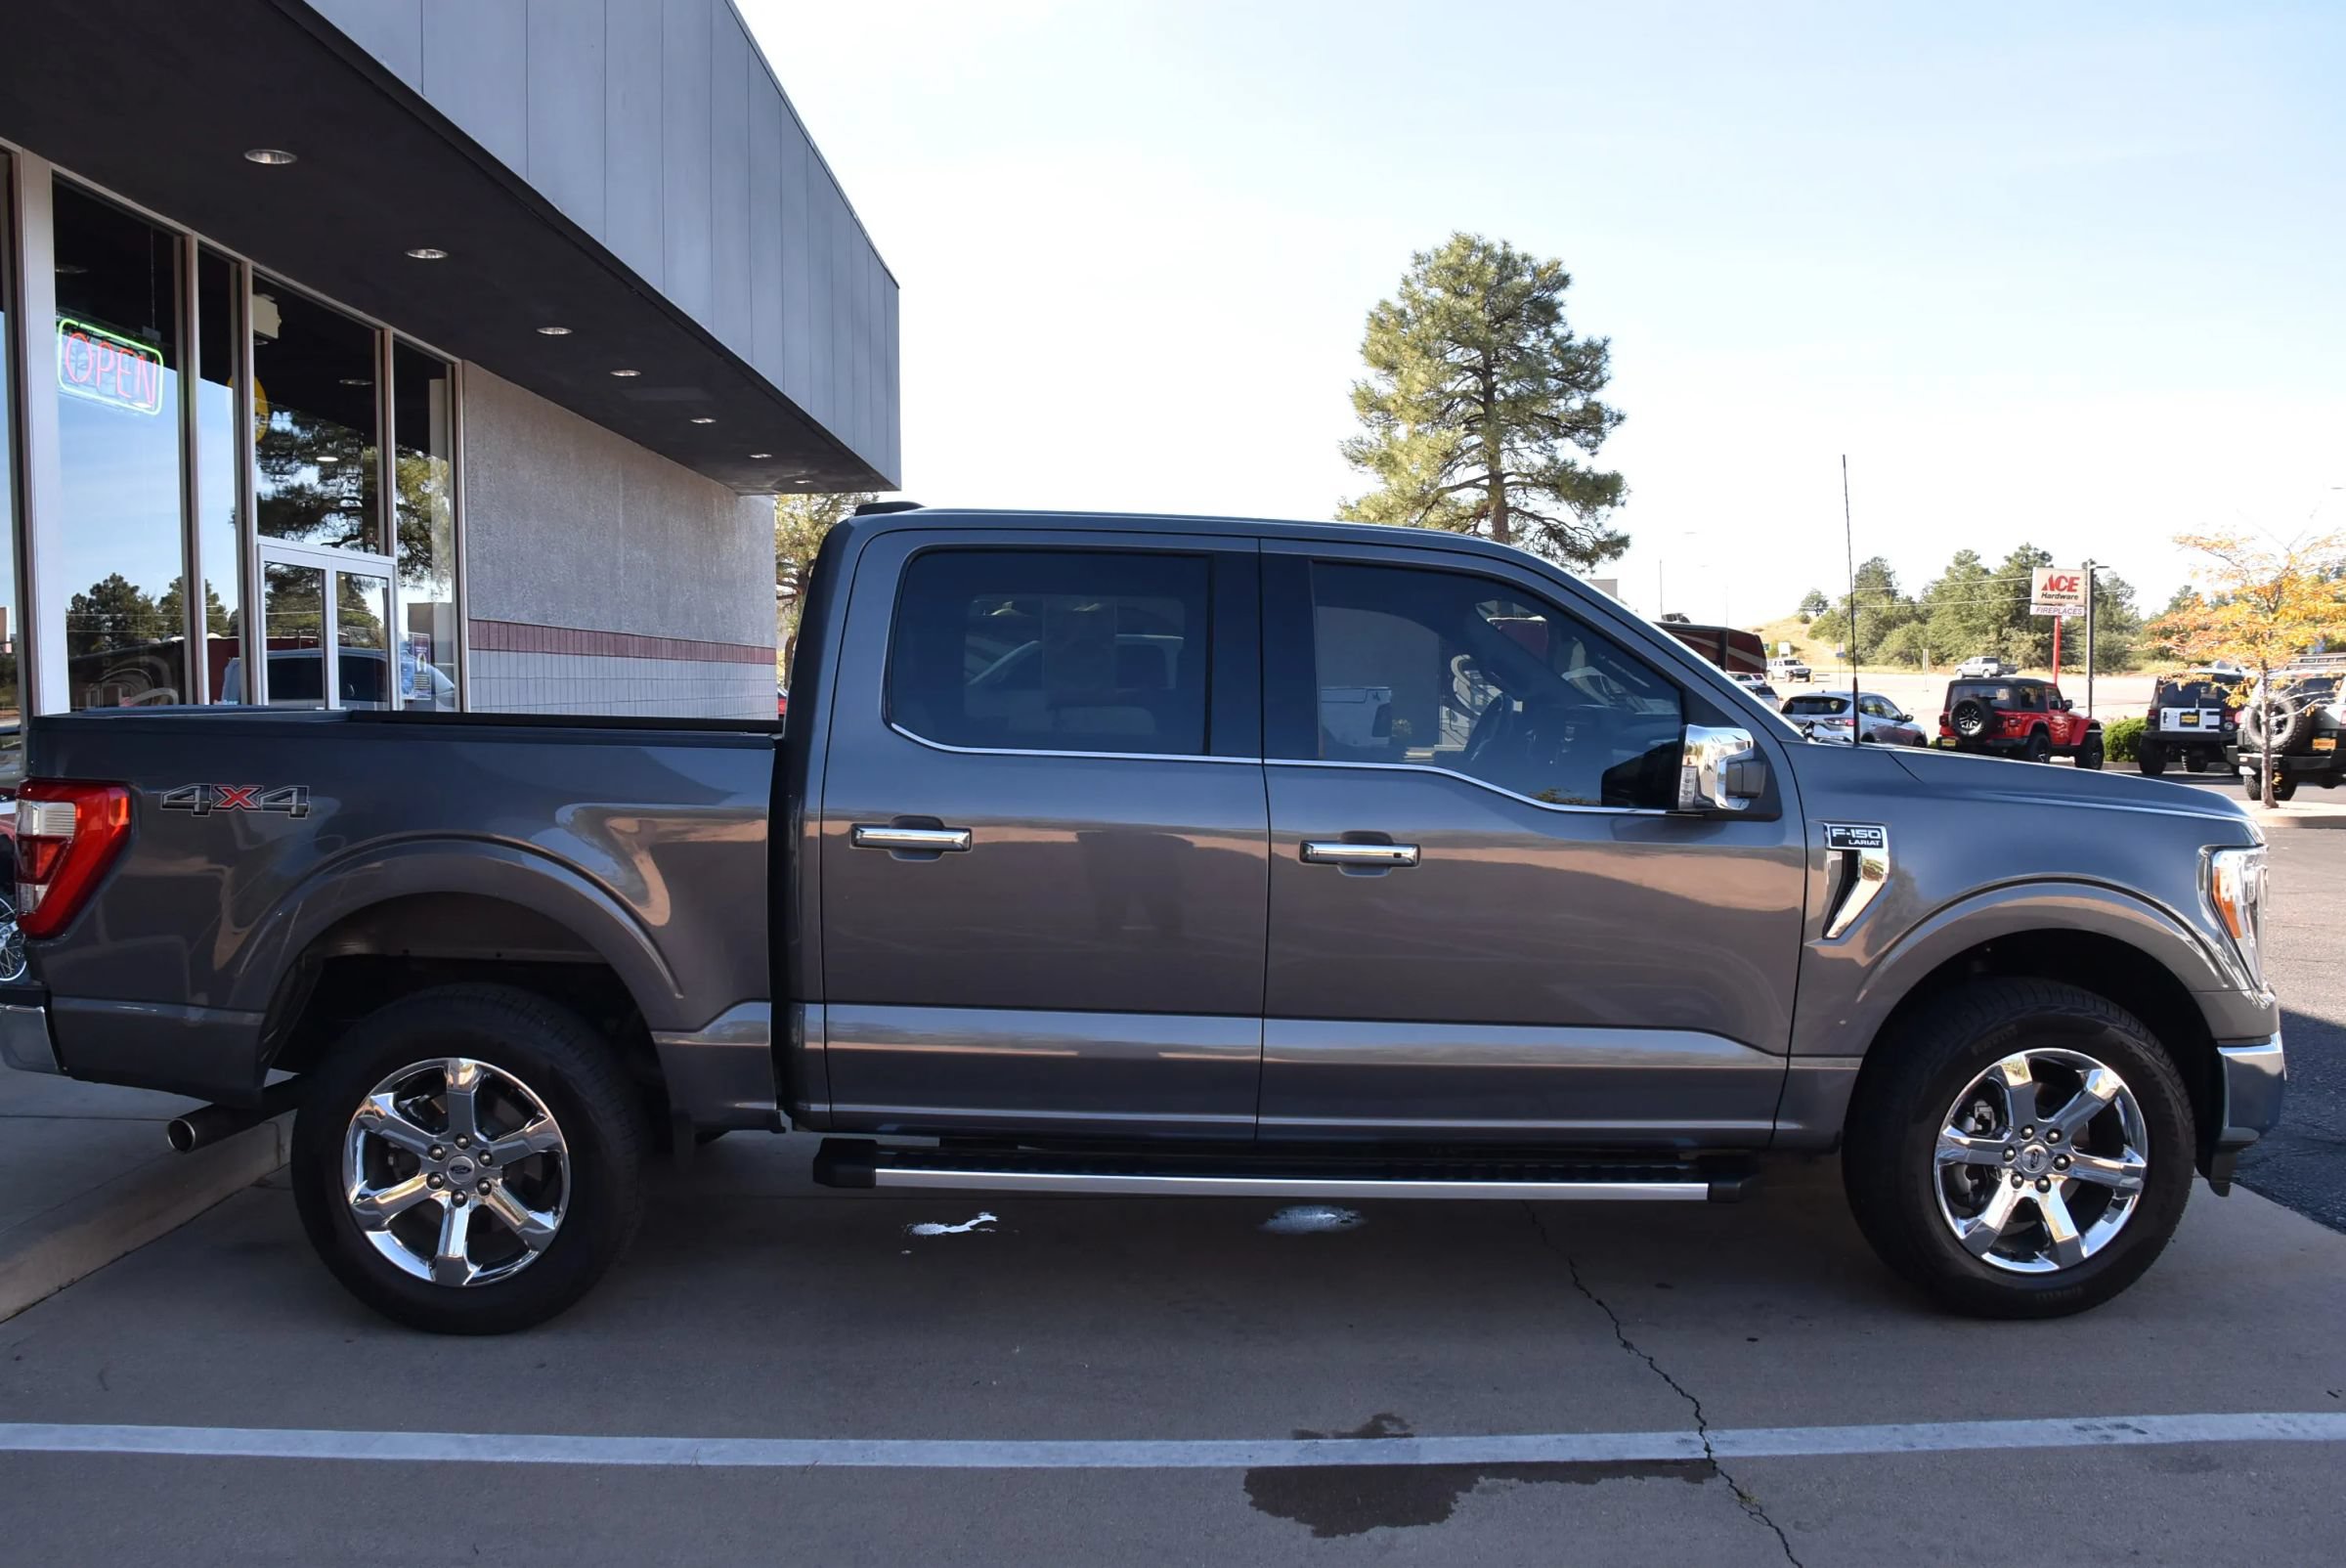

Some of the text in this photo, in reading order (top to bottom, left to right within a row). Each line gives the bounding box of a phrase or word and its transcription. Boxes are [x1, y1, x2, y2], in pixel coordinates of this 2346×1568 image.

[65, 331, 157, 408] OPEN
[2041, 574, 2080, 592] ACE
[1832, 828, 1882, 839] F-150
